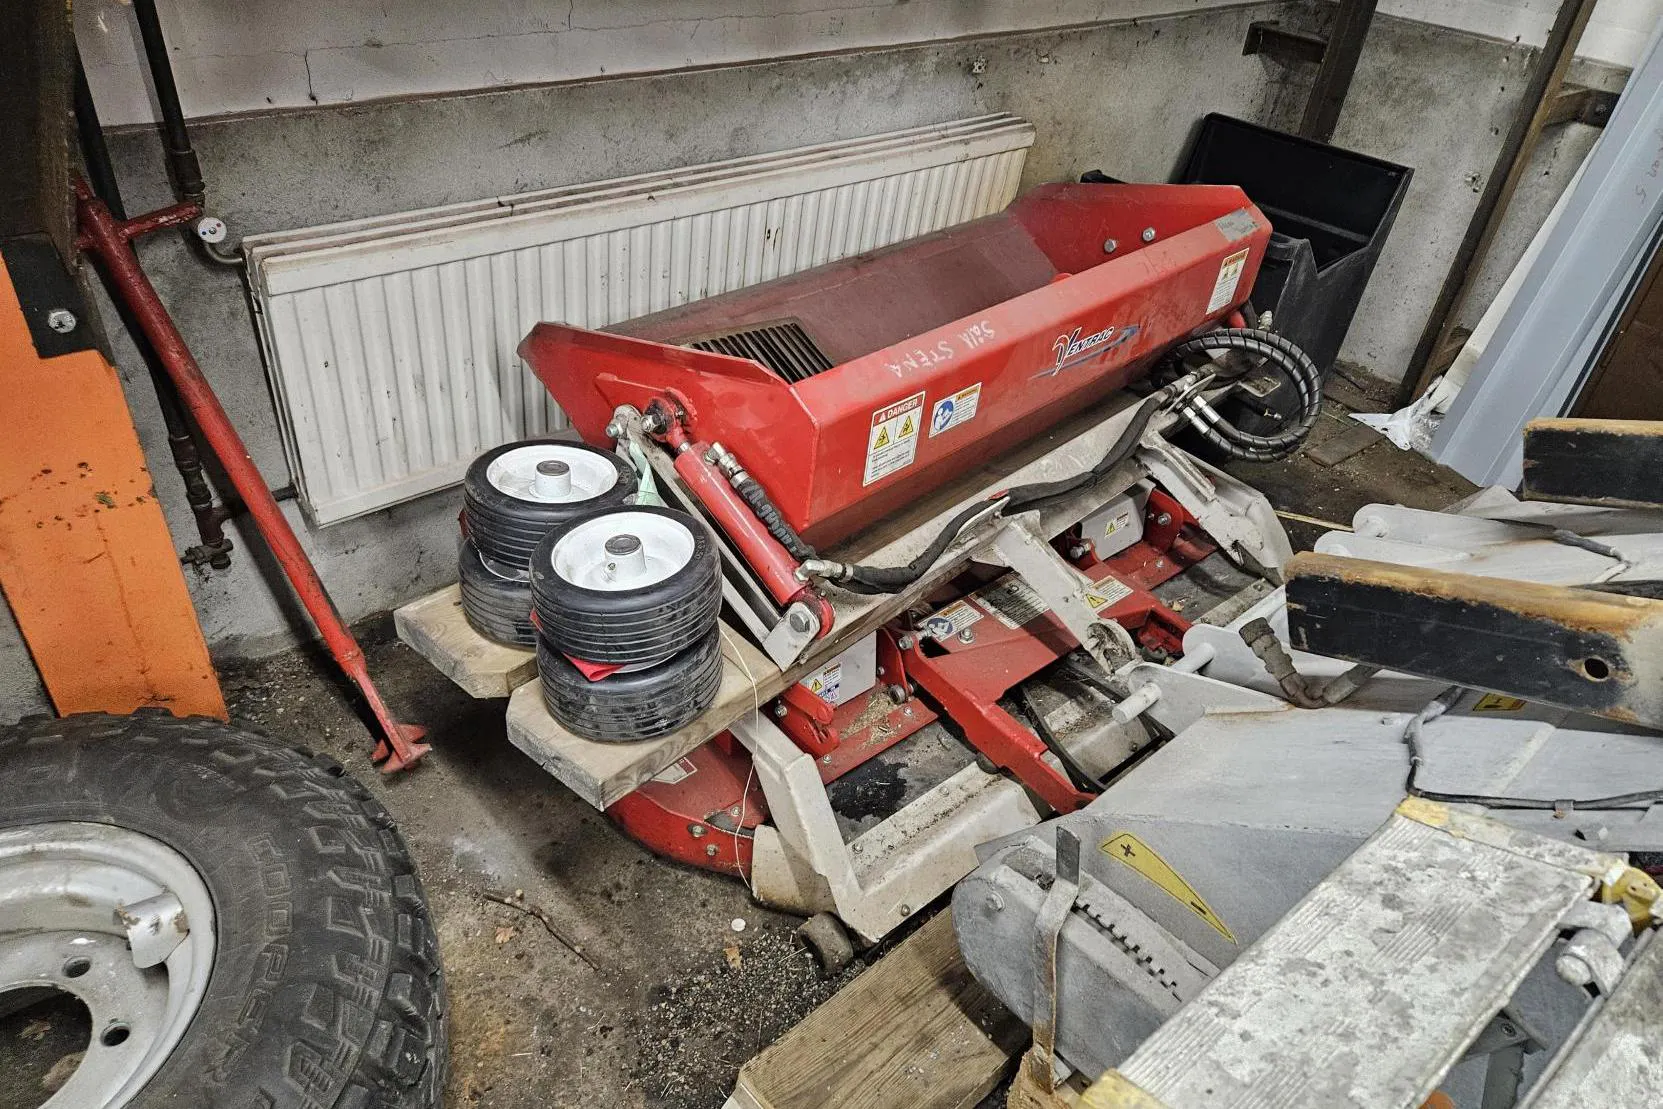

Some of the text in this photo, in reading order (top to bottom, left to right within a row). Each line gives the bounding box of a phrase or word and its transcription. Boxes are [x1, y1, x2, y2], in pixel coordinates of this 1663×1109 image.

[883, 341, 954, 378] STENA
[1052, 326, 1115, 376] VENTRAC
[887, 399, 919, 417] DANGER
